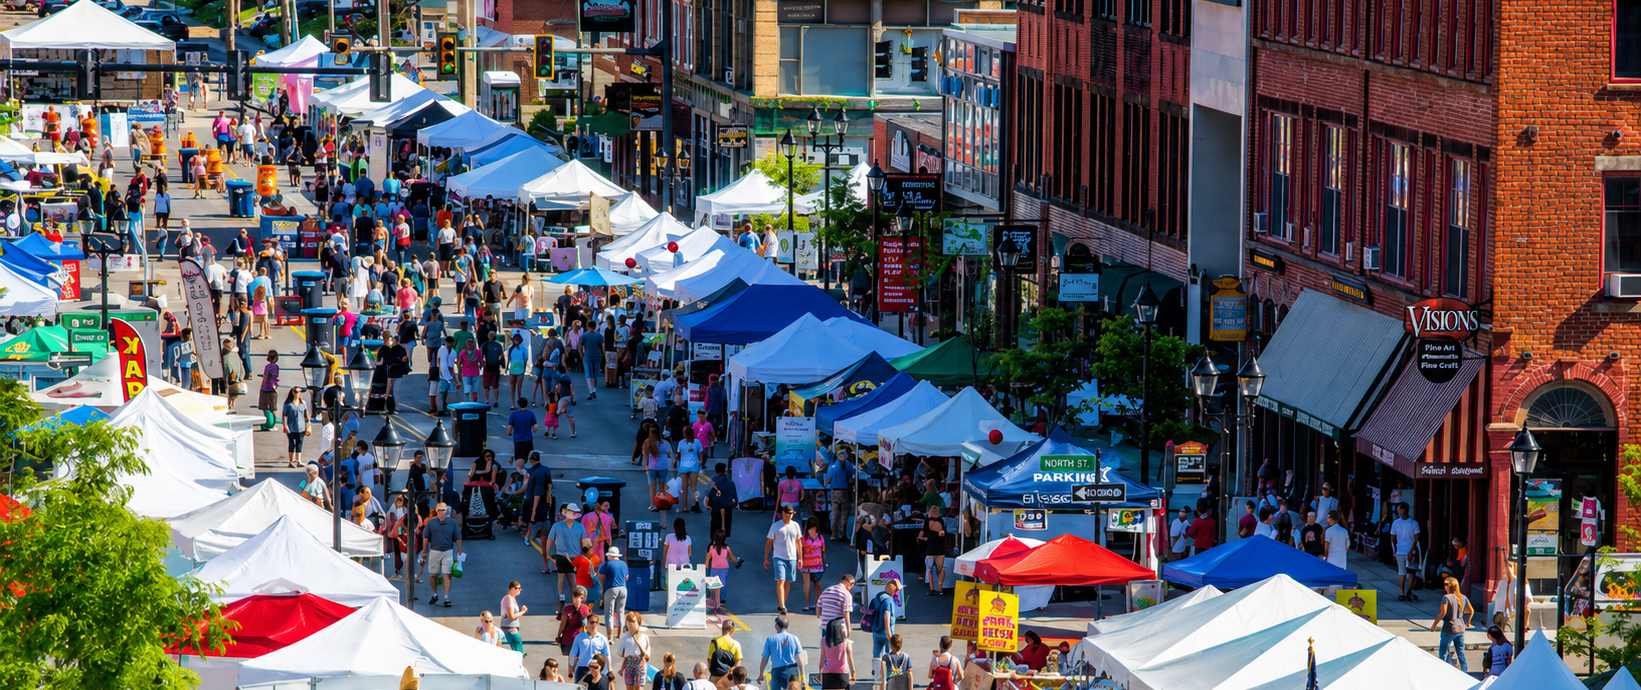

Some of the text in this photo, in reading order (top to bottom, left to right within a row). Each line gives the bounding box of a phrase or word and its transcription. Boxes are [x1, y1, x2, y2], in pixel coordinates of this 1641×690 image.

[1406, 306, 1478, 337] VISIONS
[1044, 459, 1090, 468] NORTH ST.
